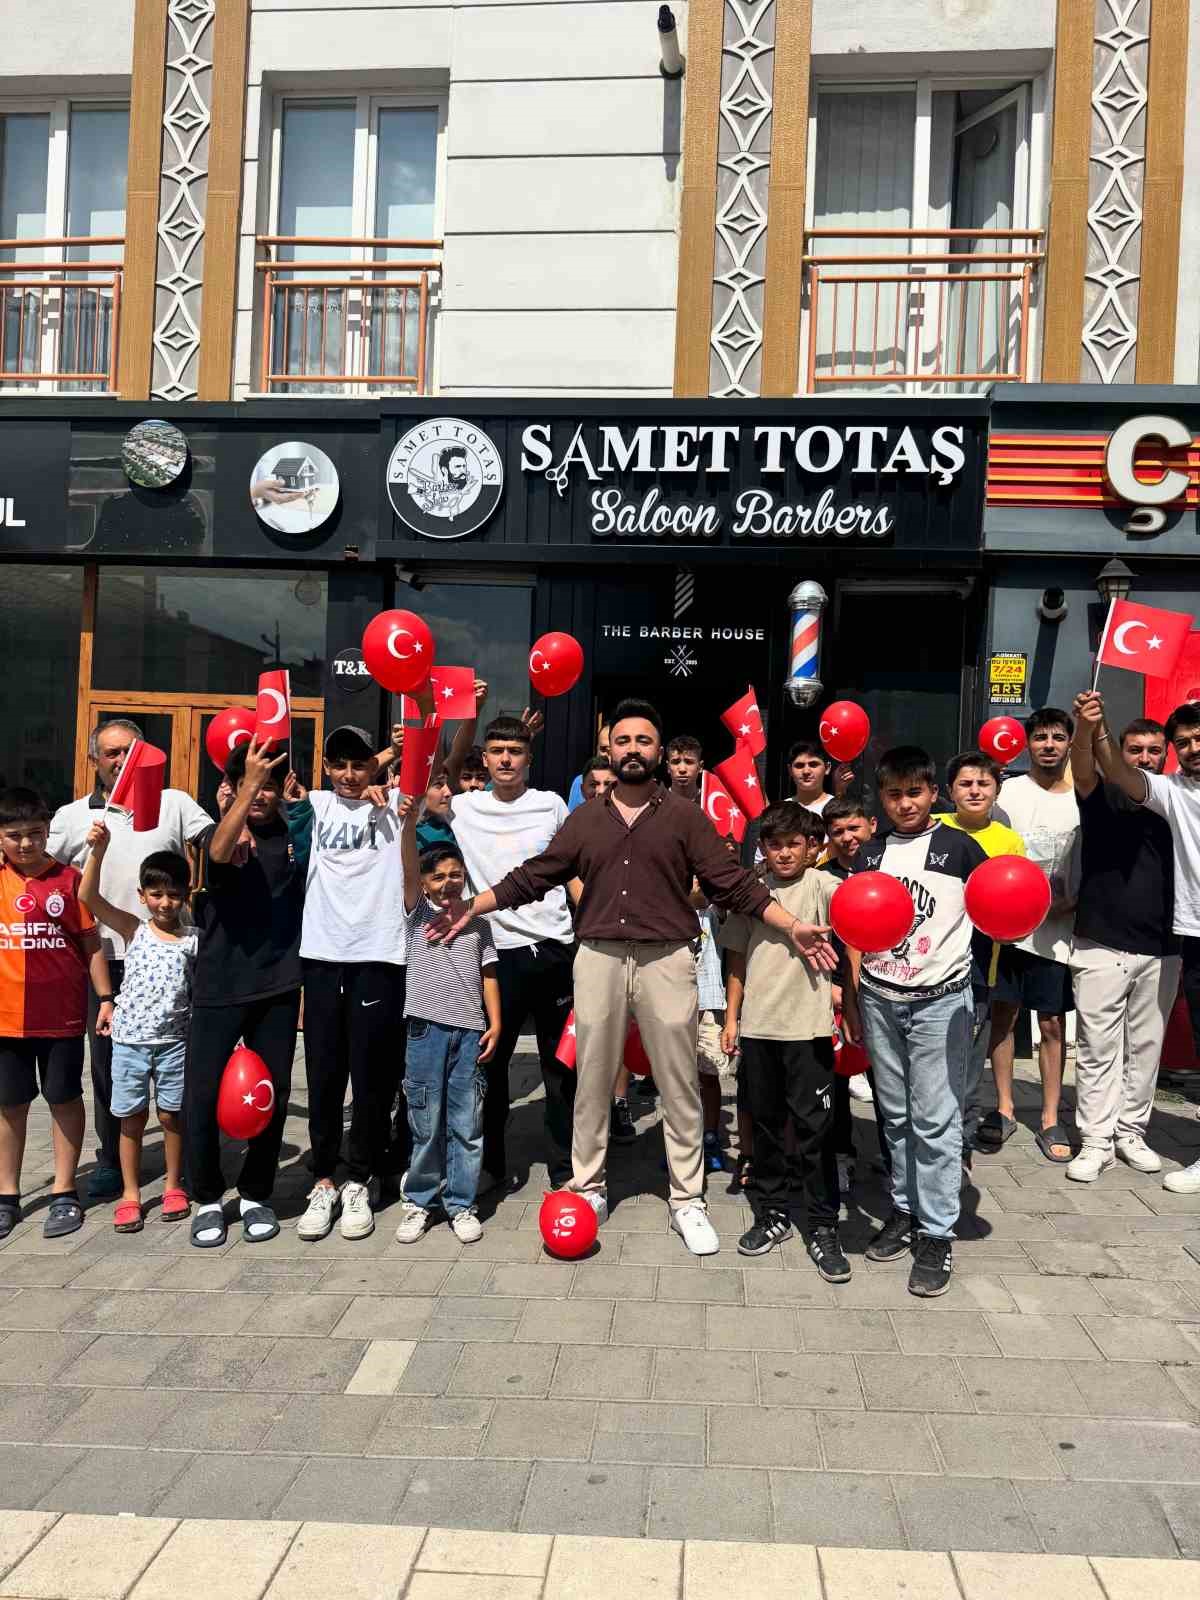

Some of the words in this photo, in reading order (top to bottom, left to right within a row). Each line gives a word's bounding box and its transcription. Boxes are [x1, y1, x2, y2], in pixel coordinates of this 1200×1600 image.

[393, 424, 442, 480] SAMET
[453, 425, 497, 481] TOTAŞ
[521, 423, 739, 496] SAMET
[754, 425, 965, 485] TOTAŞ
[1107, 415, 1192, 533] Ç
[0, 497, 26, 527] L
[590, 487, 720, 534] Saloon
[731, 487, 894, 534] Barbers
[602, 625, 632, 638] THE
[639, 625, 704, 640] BARBER
[711, 628, 765, 641] HOUSE
[333, 660, 371, 676] T&K
[992, 665, 1022, 674] 7/24
[991, 684, 1022, 695] ARS
